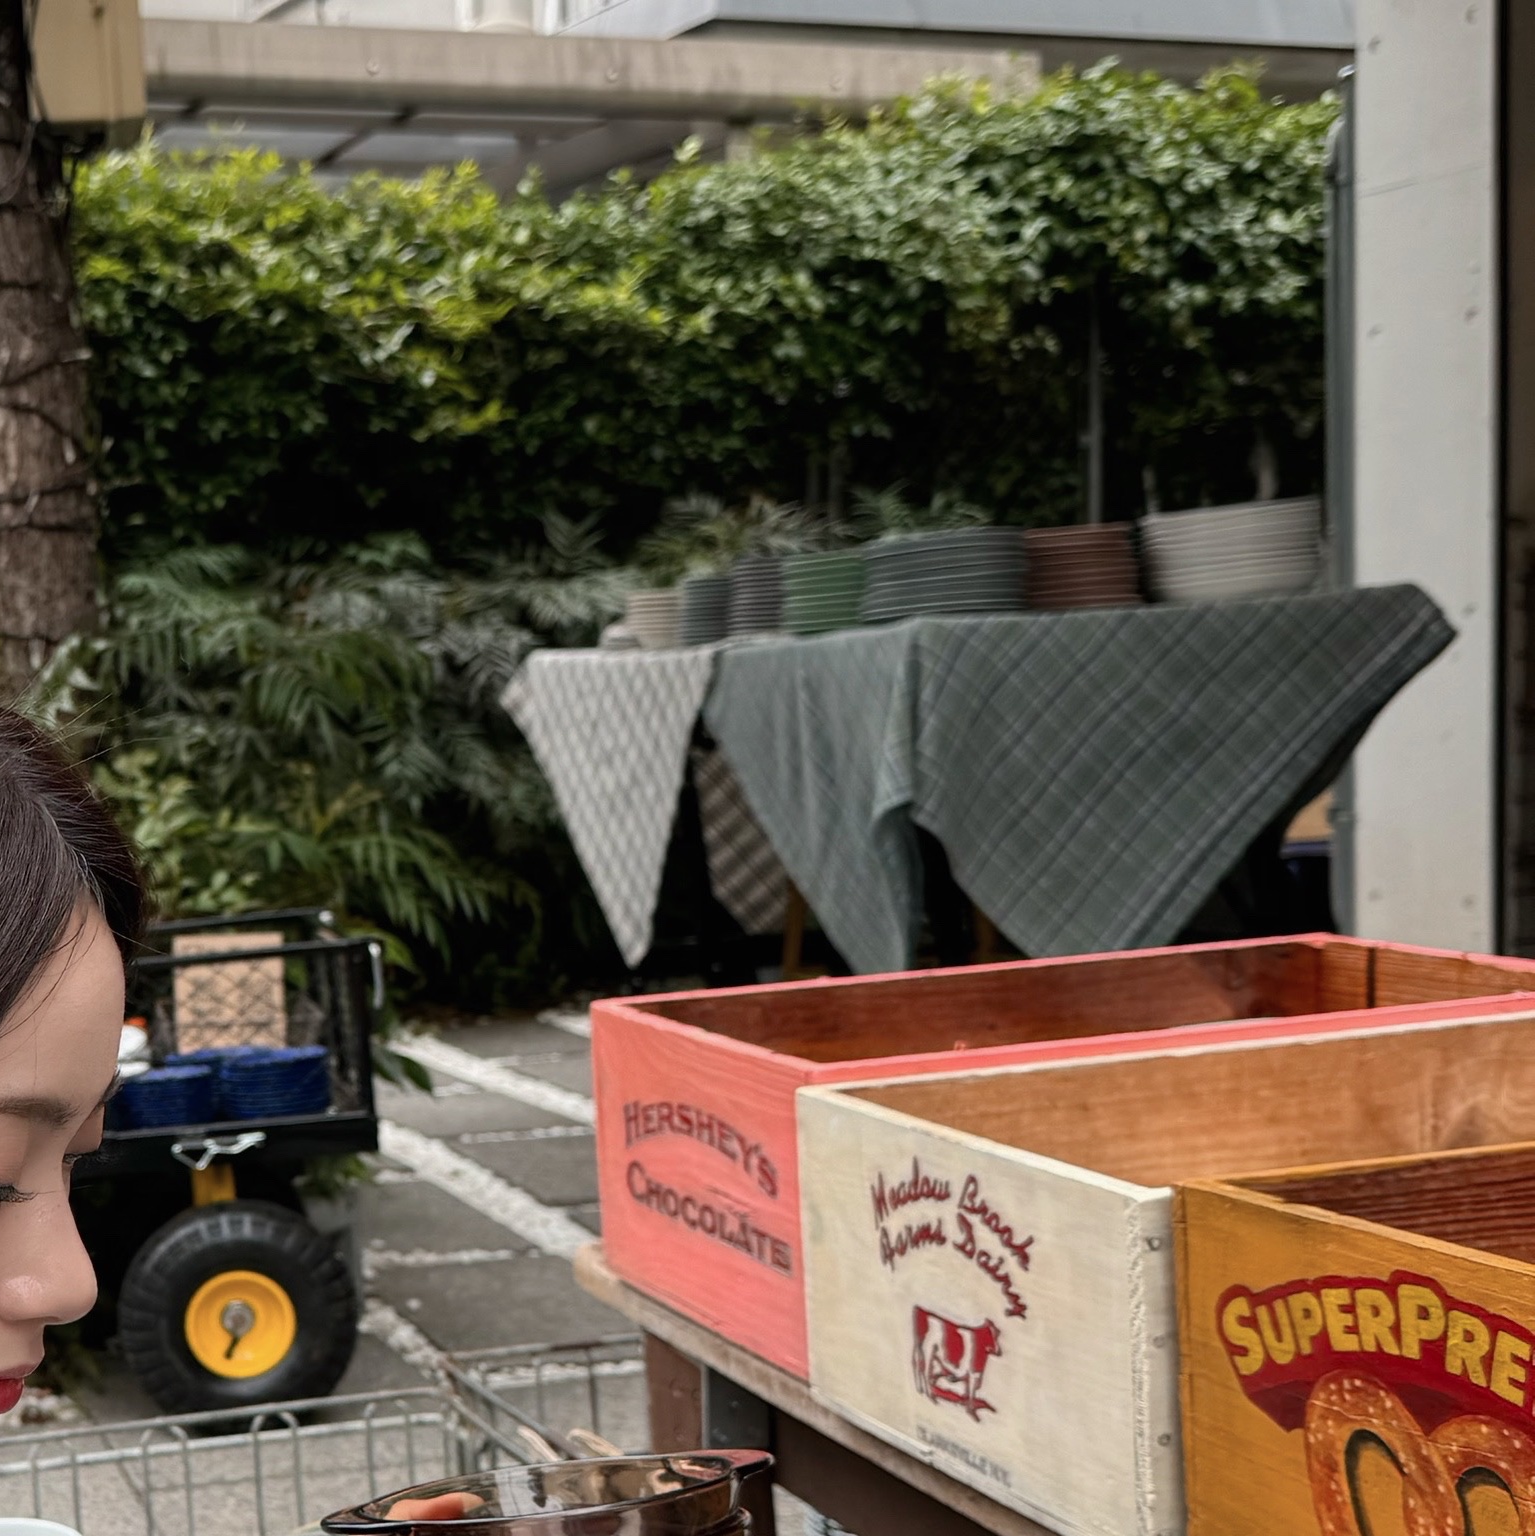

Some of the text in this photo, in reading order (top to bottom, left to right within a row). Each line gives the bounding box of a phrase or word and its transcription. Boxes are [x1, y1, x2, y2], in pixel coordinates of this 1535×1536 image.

[623, 1100, 778, 1199] HERSHEY'S
[626, 1160, 793, 1276] CHOCOLATE
[871, 1155, 1035, 1271] Meadow Brook
[952, 1211, 1027, 1319] Dairy
[1222, 1283, 1535, 1416] SUPERPRE
